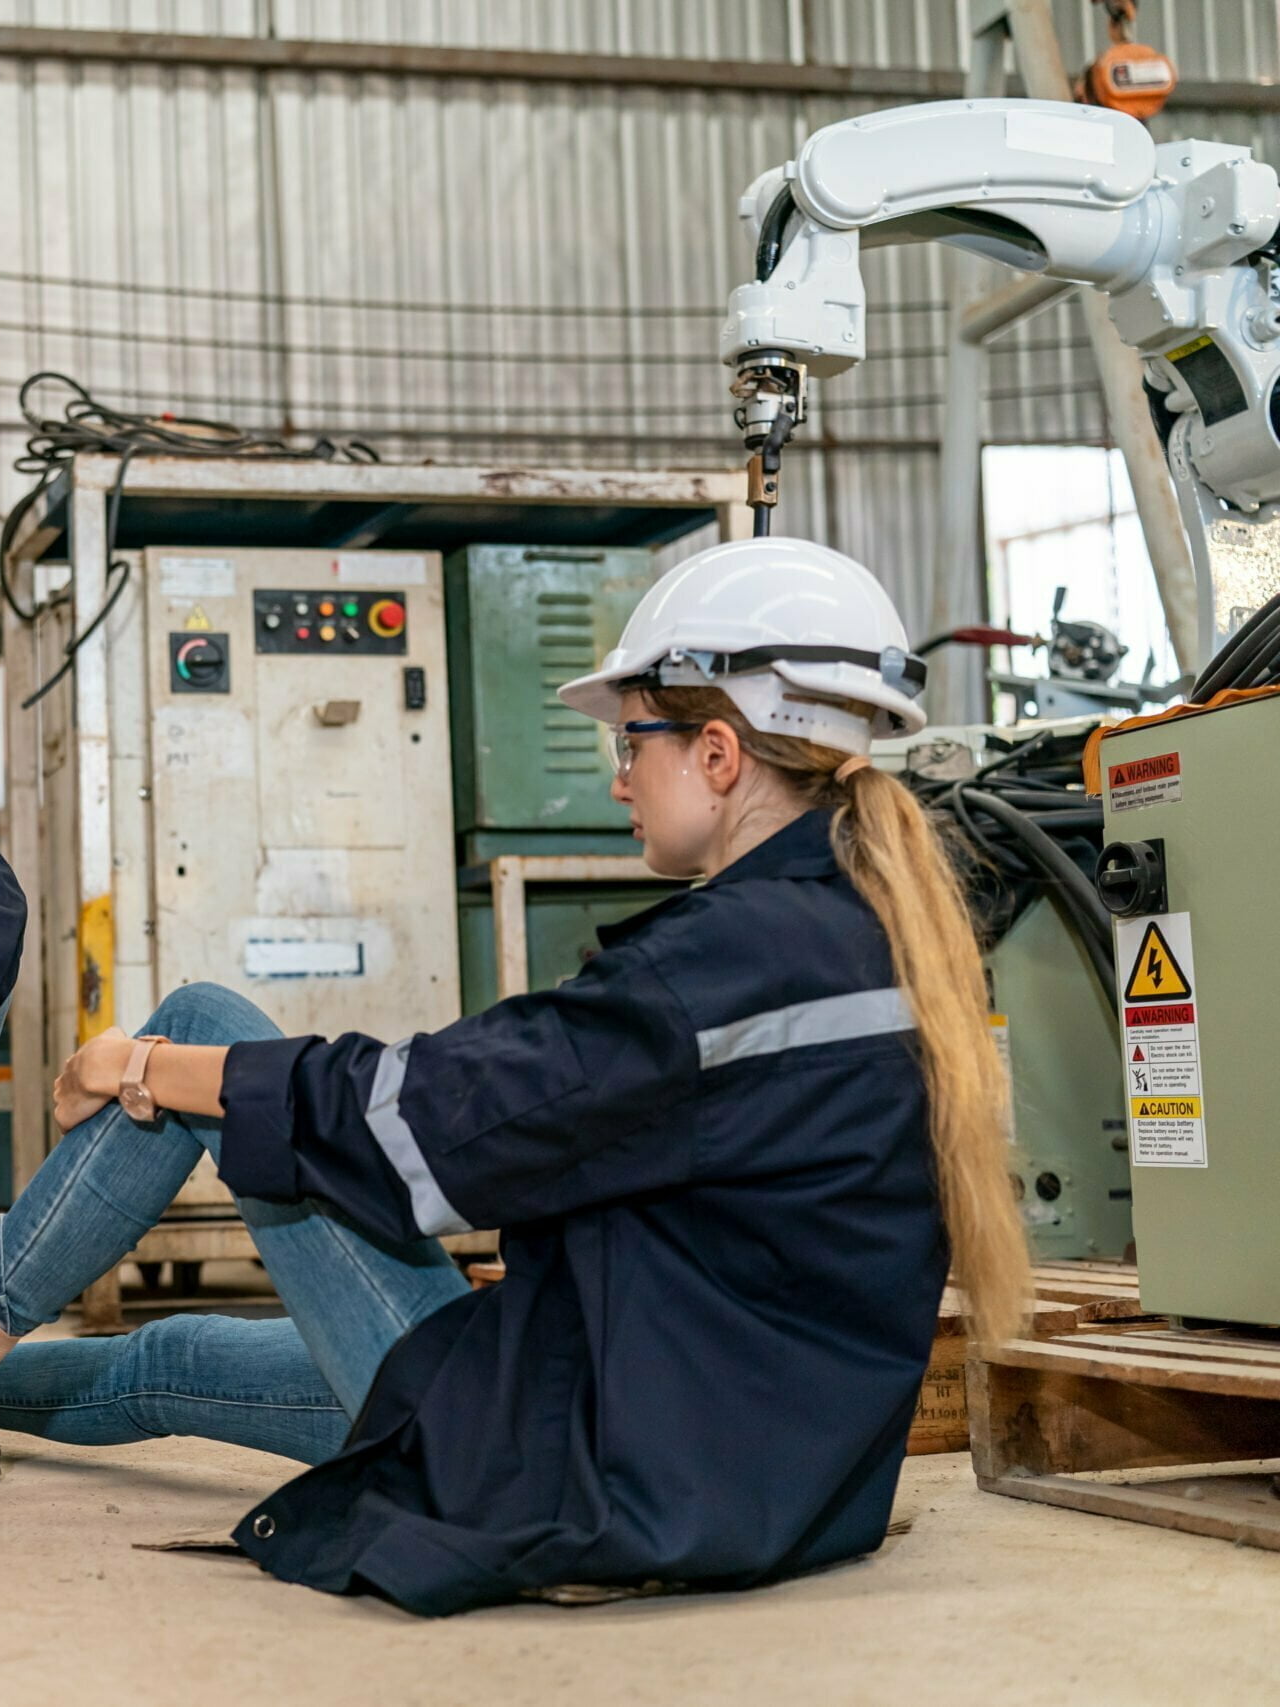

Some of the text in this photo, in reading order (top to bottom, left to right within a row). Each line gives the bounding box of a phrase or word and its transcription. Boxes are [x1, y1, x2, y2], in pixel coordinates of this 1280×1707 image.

[1126, 757, 1174, 781] WARNING
[1141, 1007, 1189, 1024] WARNING
[1149, 1102, 1194, 1115] CAUTION
[1137, 1119, 1157, 1127] Encoder
[1176, 1120, 1194, 1128] battery
